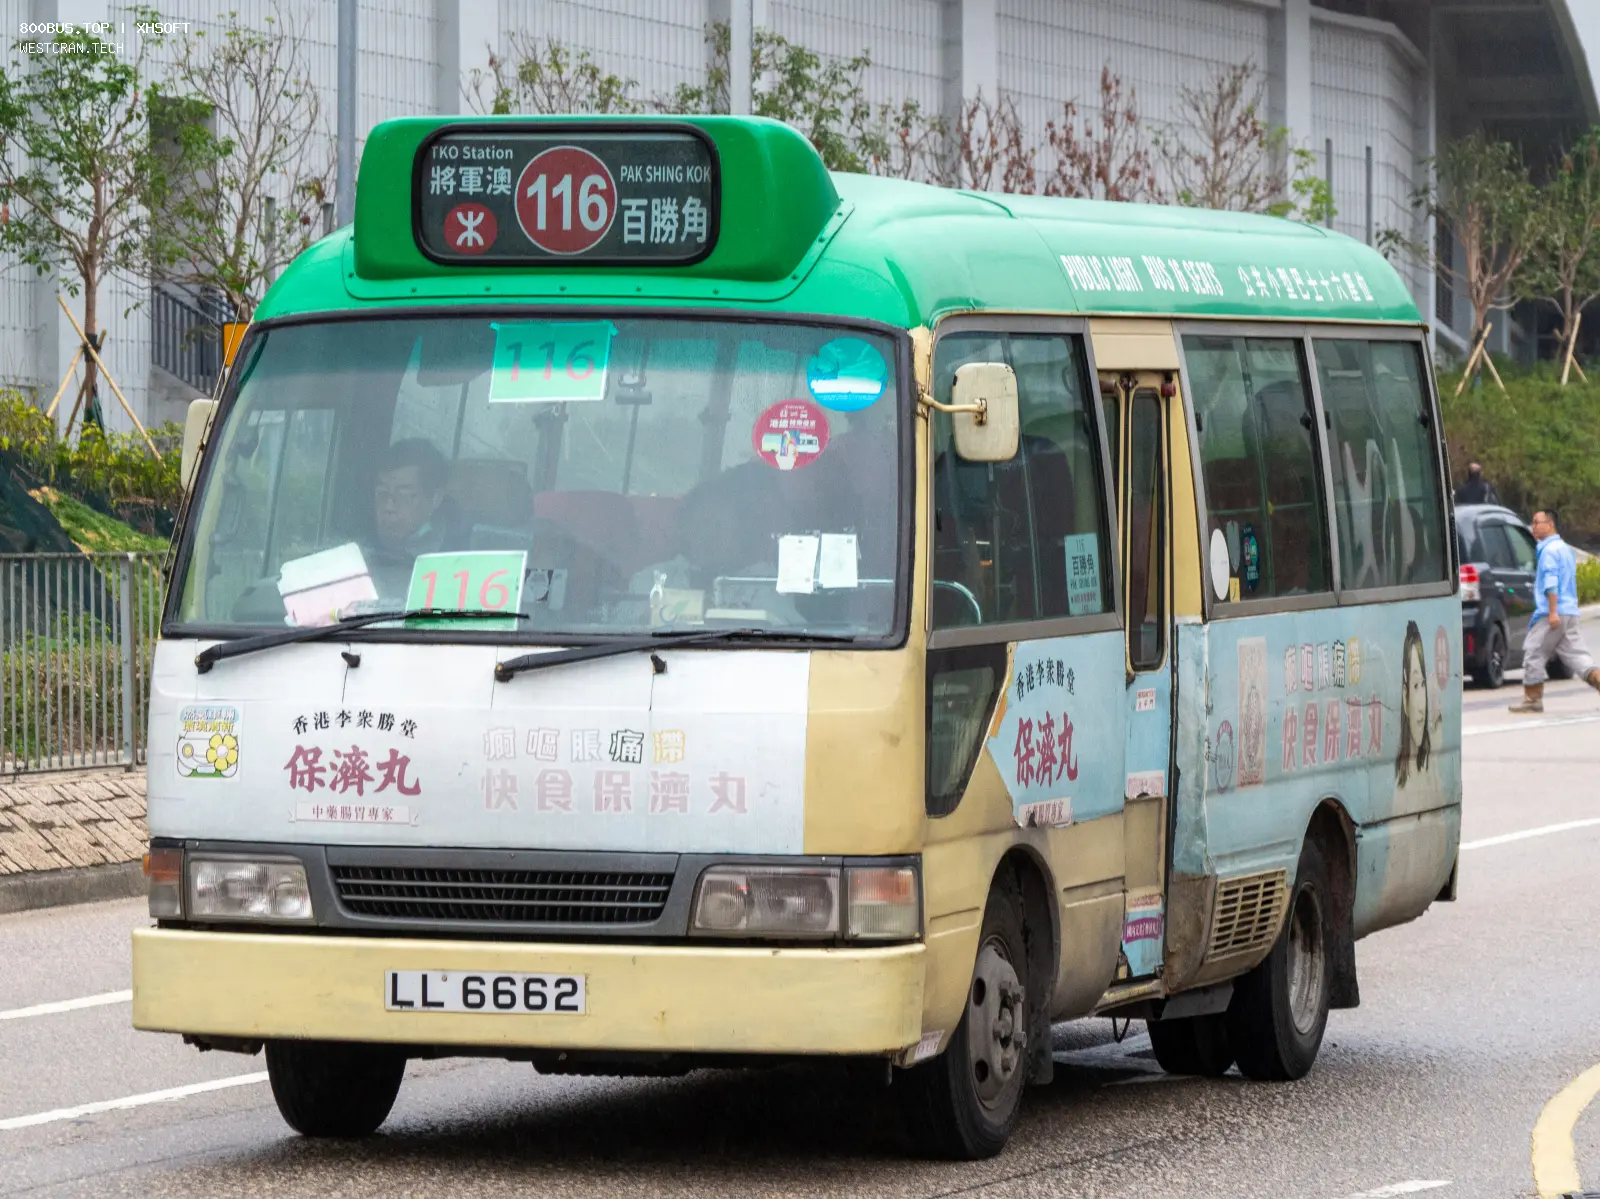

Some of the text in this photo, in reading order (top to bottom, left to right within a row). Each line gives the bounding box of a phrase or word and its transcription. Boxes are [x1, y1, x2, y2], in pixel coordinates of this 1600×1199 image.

[431, 145, 514, 160] TKO Station
[620, 164, 711, 184] PAK SHING KOK
[430, 165, 512, 196] 將軍澳
[526, 173, 608, 232] 116
[621, 196, 708, 244] 百勝角
[1060, 254, 1111, 292] PUBLIC
[1101, 255, 1144, 292] LIGHT
[1141, 254, 1175, 292] BUS
[1182, 259, 1224, 296] SEATS
[505, 339, 595, 383] 116
[421, 569, 510, 611] 116
[1013, 710, 1079, 789] 保濟丸
[1281, 693, 1382, 773] 快食保濟丸
[283, 744, 422, 797] 保濟丸
[480, 767, 748, 815] 快食保濟丸
[391, 972, 579, 1012] LL 6662
